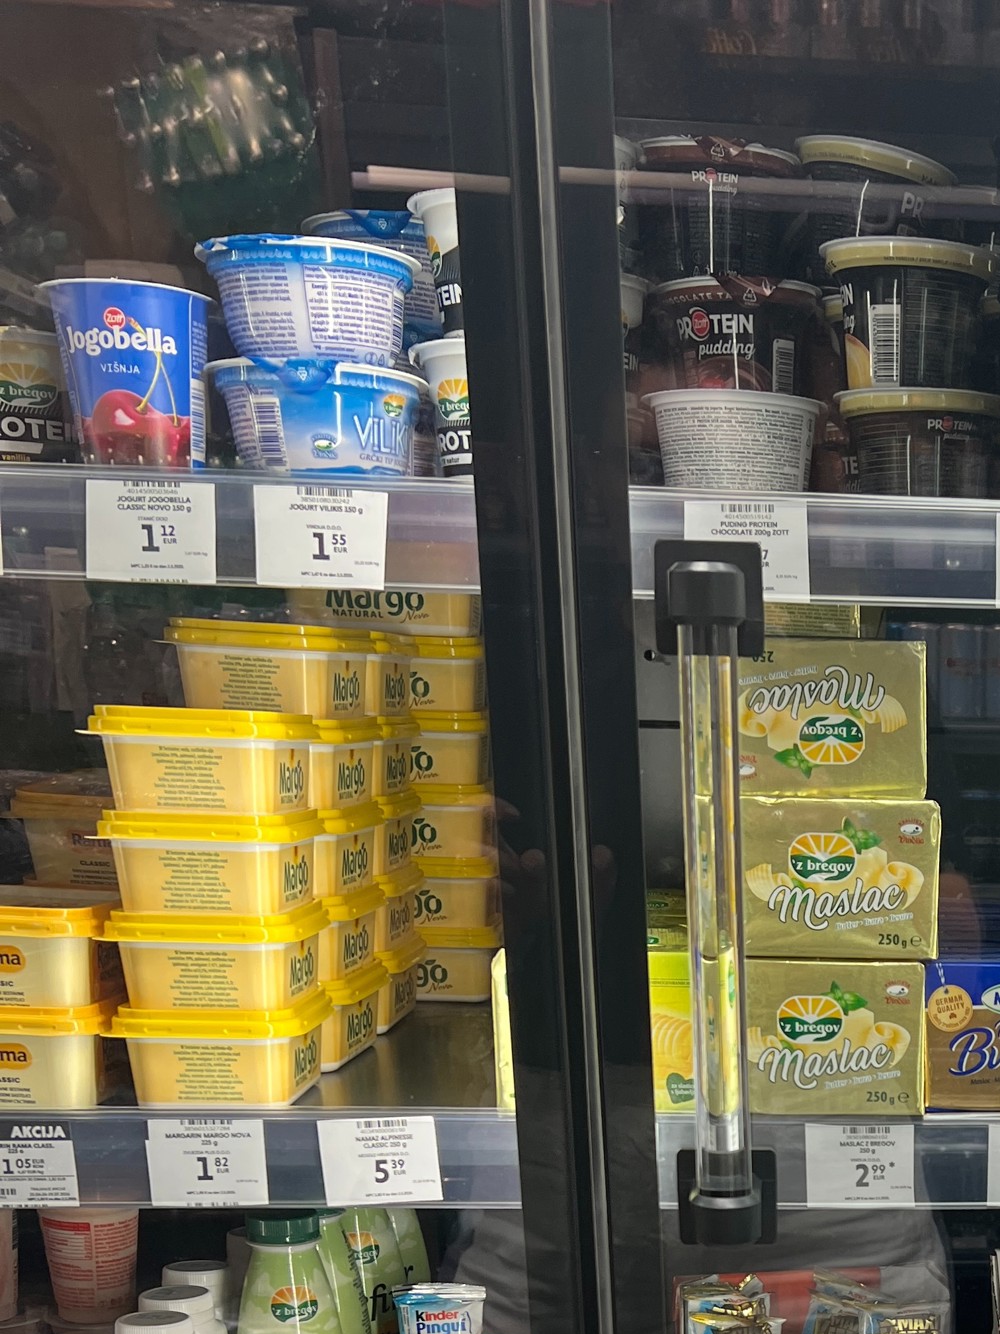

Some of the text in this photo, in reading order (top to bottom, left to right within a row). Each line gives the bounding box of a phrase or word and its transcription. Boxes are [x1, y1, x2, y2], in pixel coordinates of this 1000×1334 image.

[66, 326, 177, 356] Jogobella
[699, 340, 756, 360] pudding
[100, 361, 140, 374] VIŠNJA
[711, 528, 752, 536] CHOCOLATE
[720, 521, 778, 529] PUDING PROTEIN
[141, 524, 175, 552] 1 12
[313, 532, 347, 560] 1 55
[326, 591, 424, 617] Margo
[332, 608, 383, 618] NATURAL
[333, 671, 359, 706] Margo
[749, 665, 886, 715] Maslac
[807, 859, 853, 875] bregov
[767, 879, 906, 931] Maslac
[878, 934, 900, 947] 250
[935, 994, 963, 1006] GERMAN
[936, 1002, 965, 1014] QUALITY
[795, 1020, 840, 1038] bregov
[11, 1126, 66, 1139] AKCIJA
[3, 1159, 31, 1174] 1 05
[197, 1157, 229, 1181] 1 82
[375, 1159, 405, 1183] 5 39
[855, 1164, 886, 1187] 2 99
[415, 1310, 460, 1322] Kinder
